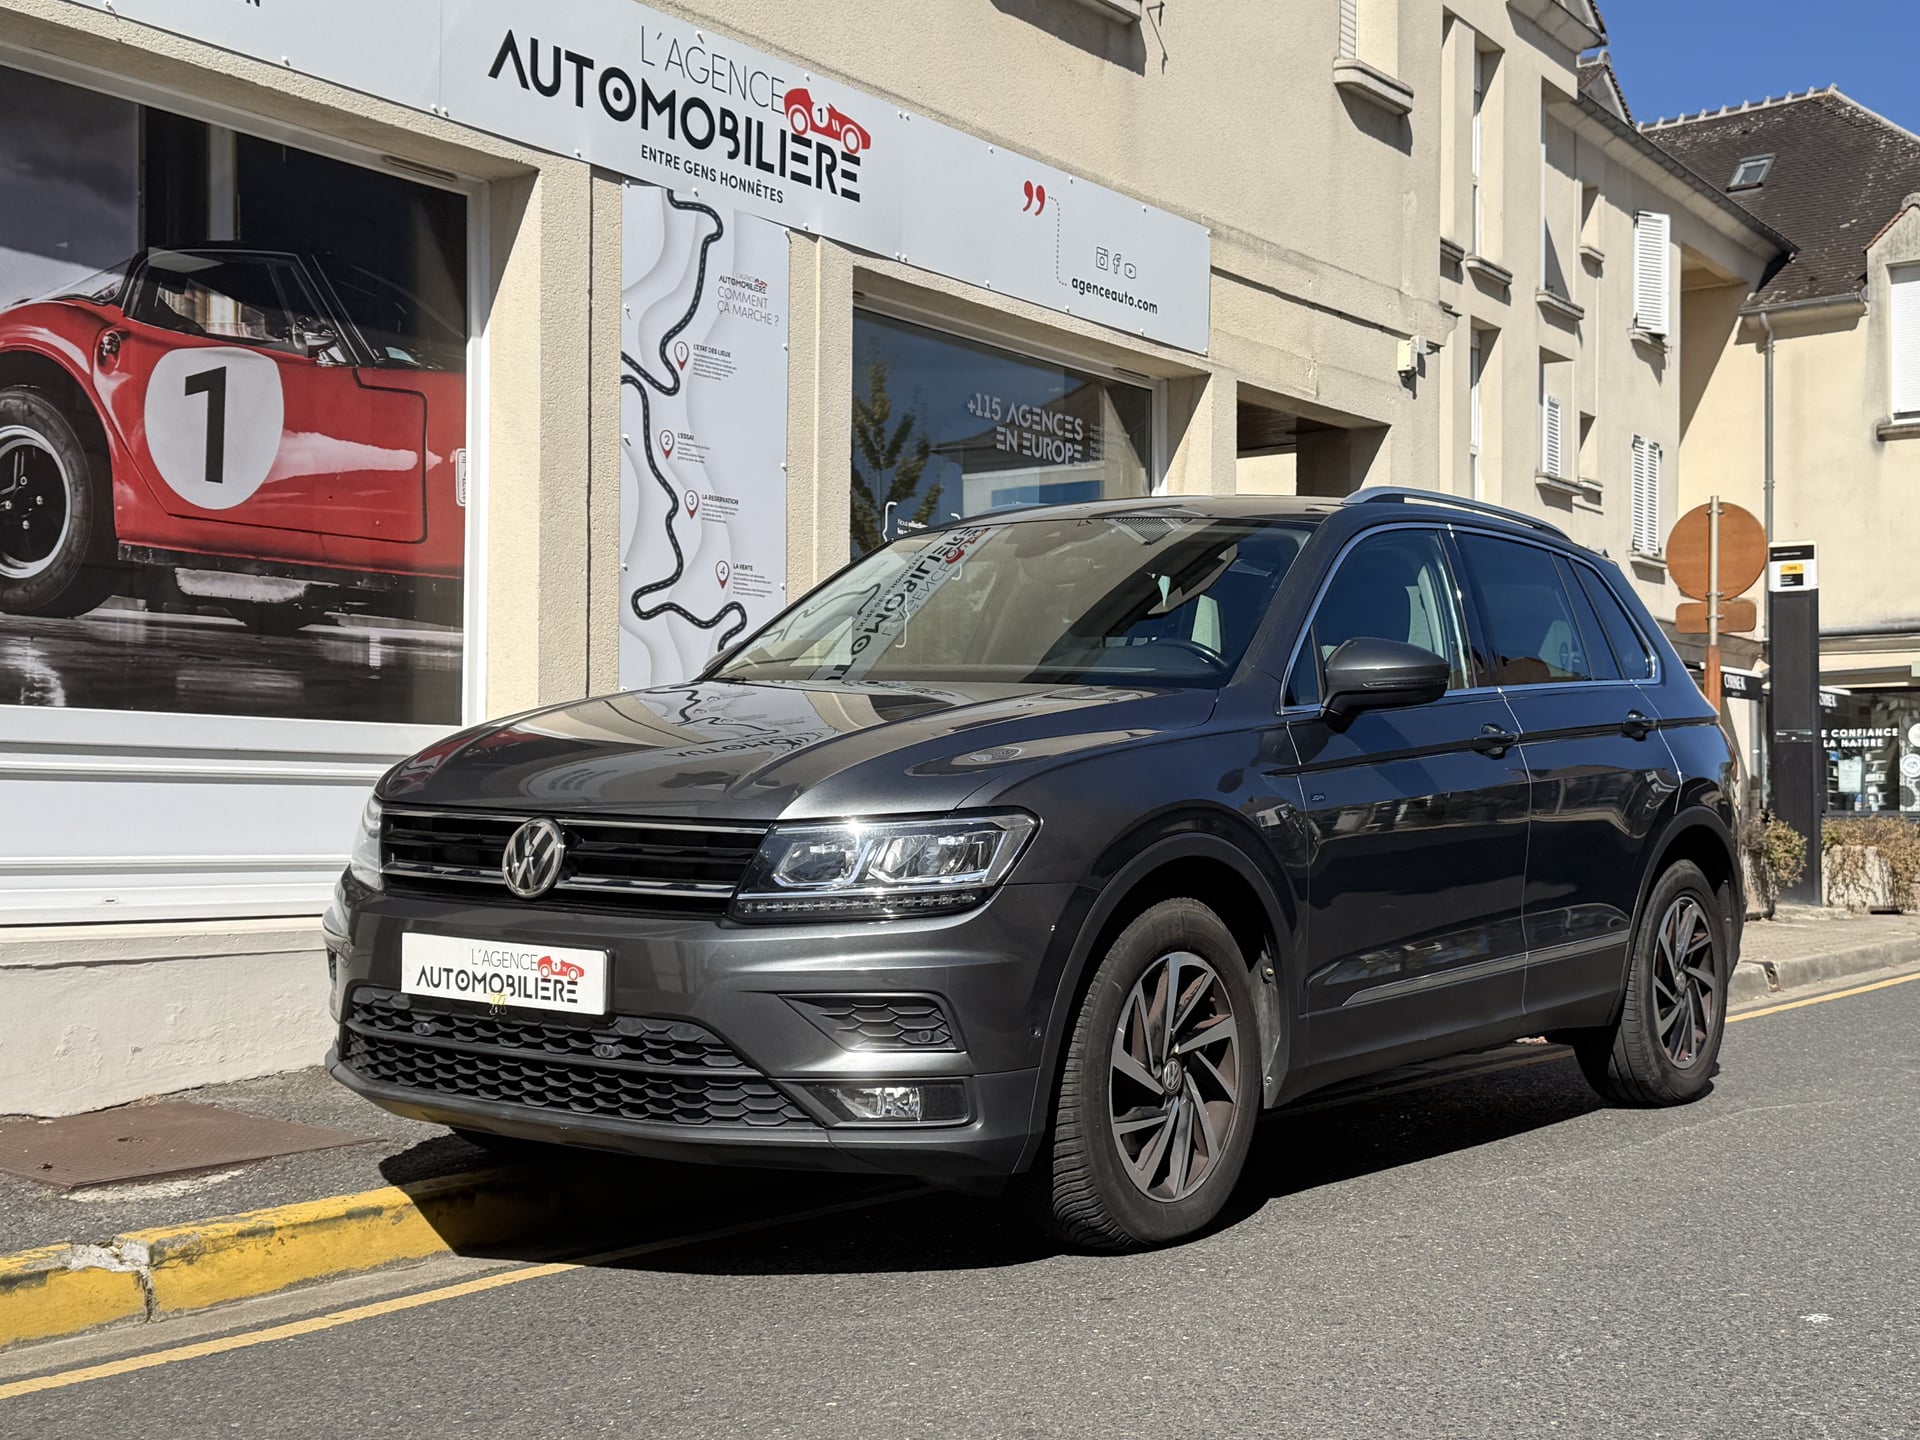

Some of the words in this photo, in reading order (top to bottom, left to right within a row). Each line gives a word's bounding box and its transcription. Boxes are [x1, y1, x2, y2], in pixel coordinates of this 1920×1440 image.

[641, 25, 785, 115] L'AGENCE
[641, 145, 680, 170] ENTRE
[684, 159, 717, 184] GENS
[720, 168, 783, 204] HONNÊTES
[717, 286, 768, 309] COMMENT
[1071, 276, 1158, 314] agenceauto.com
[717, 301, 730, 315] ÇA
[732, 304, 772, 325] MARCHE
[774, 315, 780, 326] ?
[184, 366, 227, 484] 1
[968, 393, 1001, 420] +115
[1006, 401, 1083, 441] AGENCES
[664, 435, 670, 445] 2
[996, 426, 1018, 453] EN
[1022, 432, 1083, 465] EUROPE
[689, 494, 694, 505] 3
[720, 566, 725, 575] 4
[1823, 739, 1836, 748] LA
[1841, 739, 1883, 748] NATURE
[1831, 728, 1899, 738] CONFIANCE
[472, 948, 538, 971] L'AGENCE
